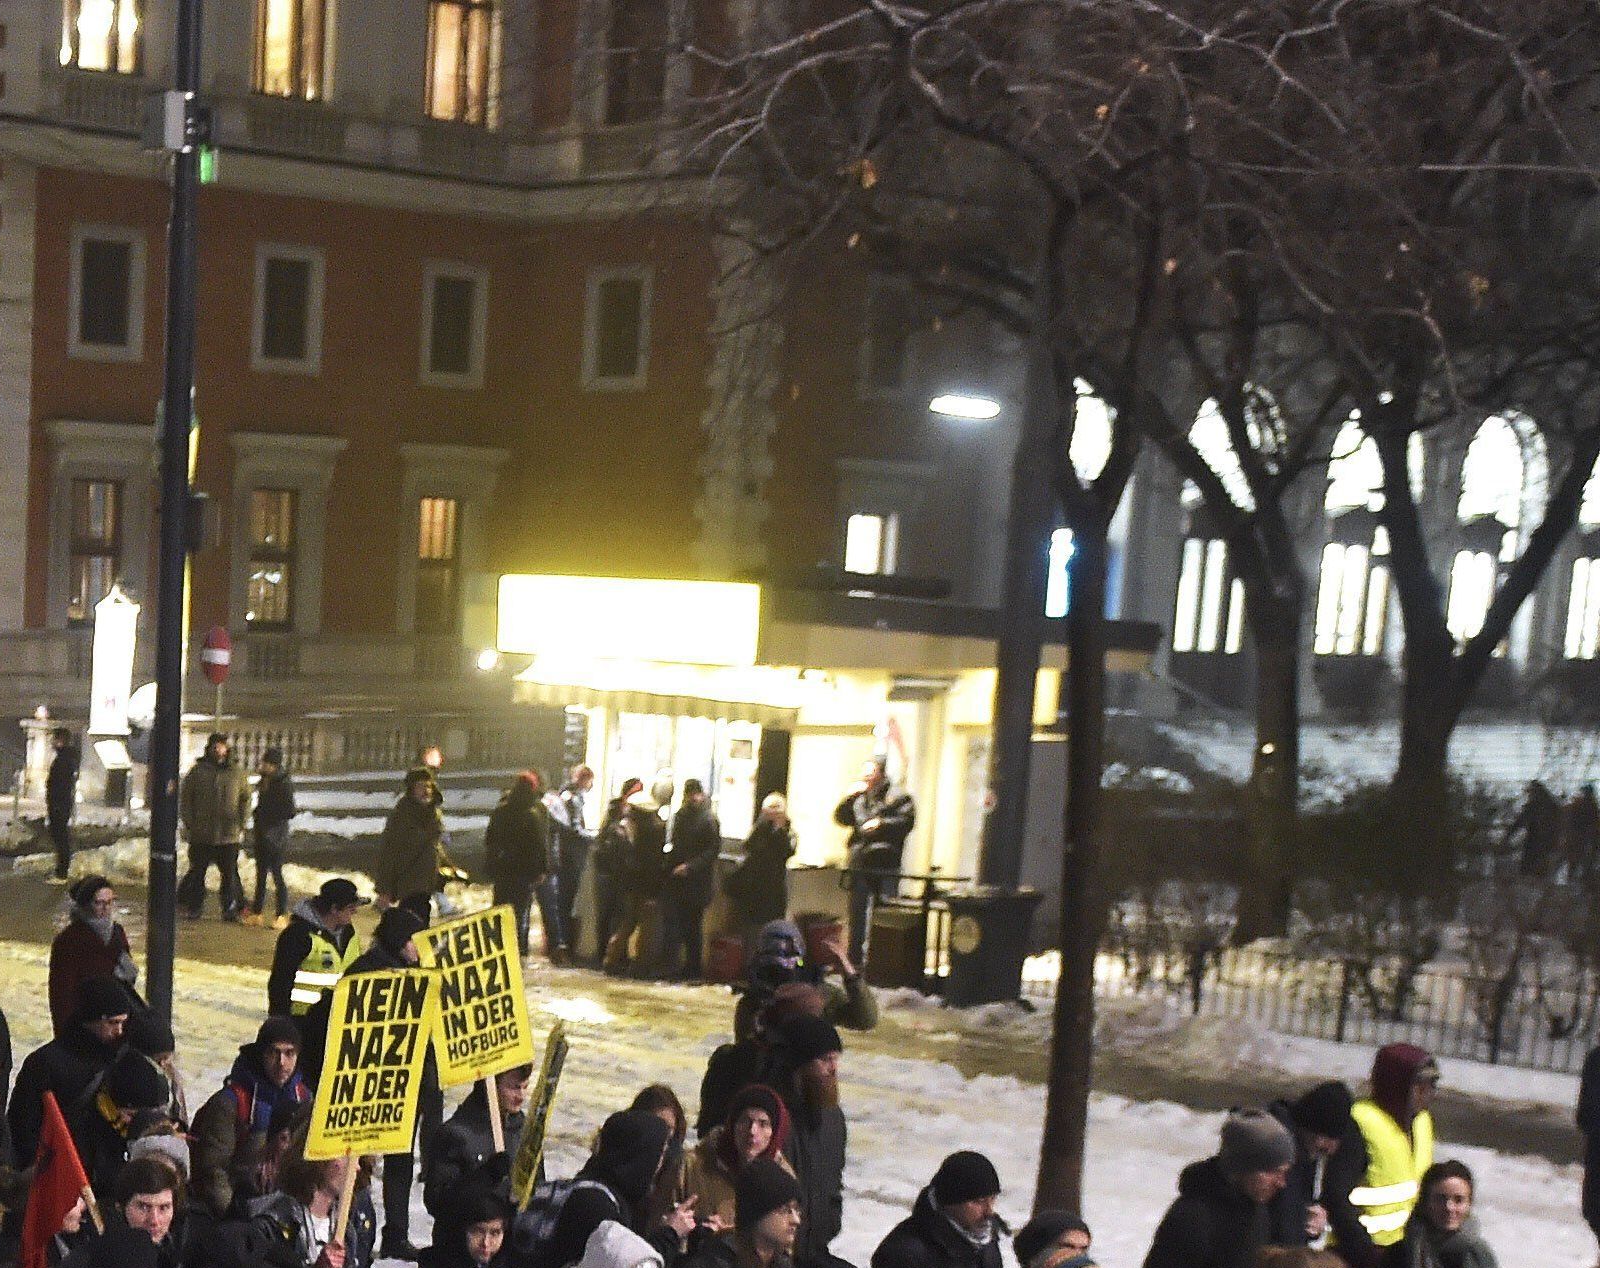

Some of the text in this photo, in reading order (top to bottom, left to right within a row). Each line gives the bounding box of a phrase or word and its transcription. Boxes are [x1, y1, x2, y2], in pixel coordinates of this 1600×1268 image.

[428, 914, 504, 967] KEIN
[344, 974, 430, 1024] KEIN
[441, 954, 511, 1011] NAZI
[442, 994, 515, 1040] IN DER
[336, 1024, 419, 1071] NAZI
[447, 1022, 519, 1062] HOFBURG
[330, 1070, 410, 1105] IN DER
[325, 1102, 405, 1129] HOFBURG
